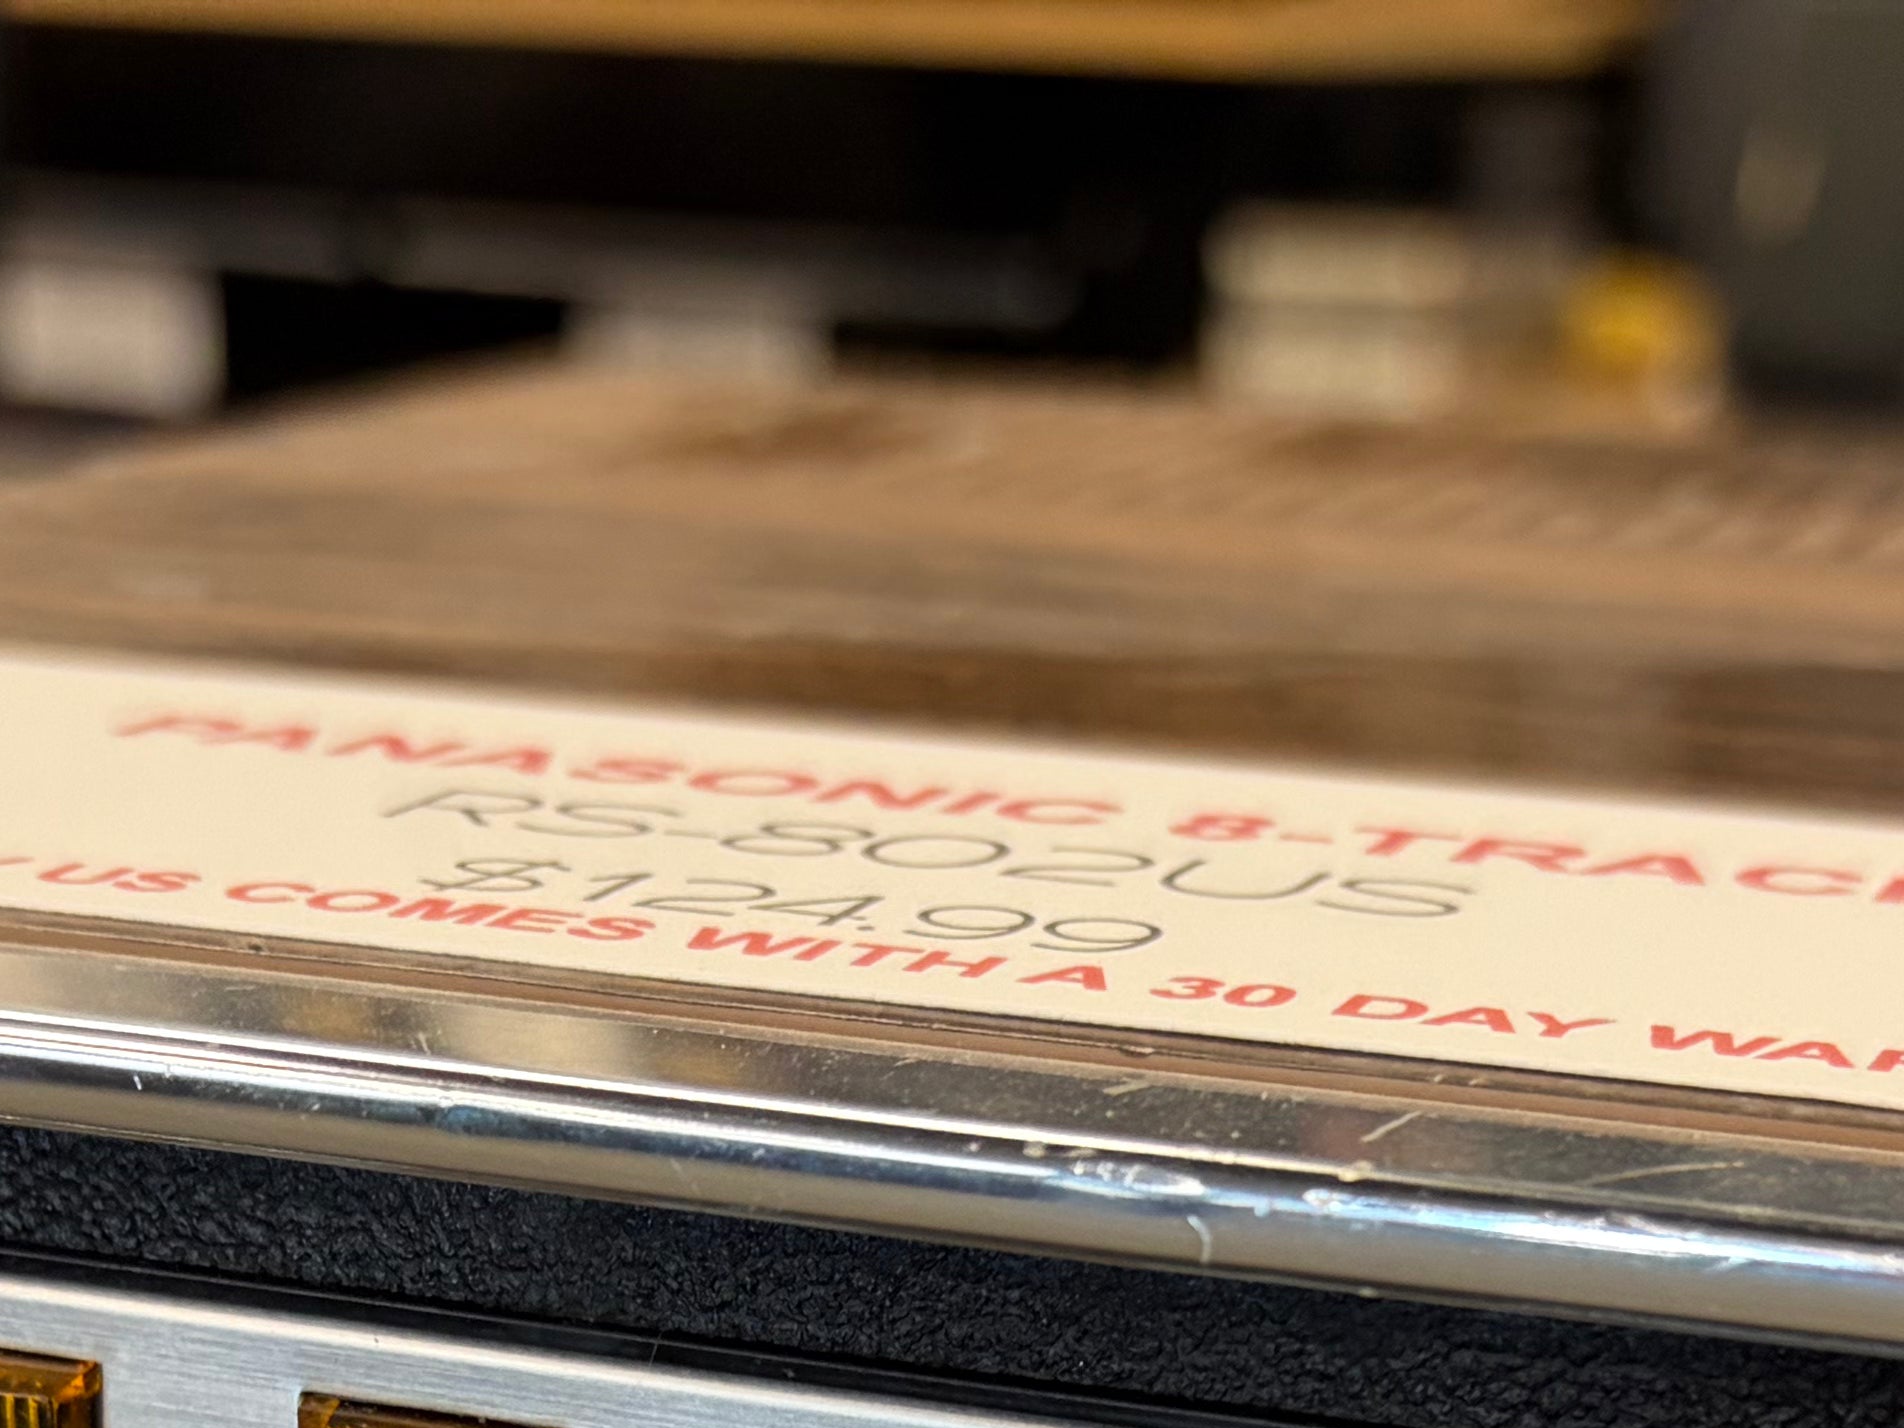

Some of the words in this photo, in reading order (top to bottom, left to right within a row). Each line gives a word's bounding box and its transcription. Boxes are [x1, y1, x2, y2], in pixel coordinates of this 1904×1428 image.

[110, 712, 1124, 826] PANASONIC
[382, 785, 1484, 922] RS-802US
[414, 855, 1166, 958] $124.99
[38, 863, 202, 893] US
[224, 876, 654, 942] COMES
[684, 924, 1010, 980] WITH
[1016, 962, 1109, 992] A
[1152, 974, 1298, 1008] 30
[1328, 994, 1612, 1040] DAY
